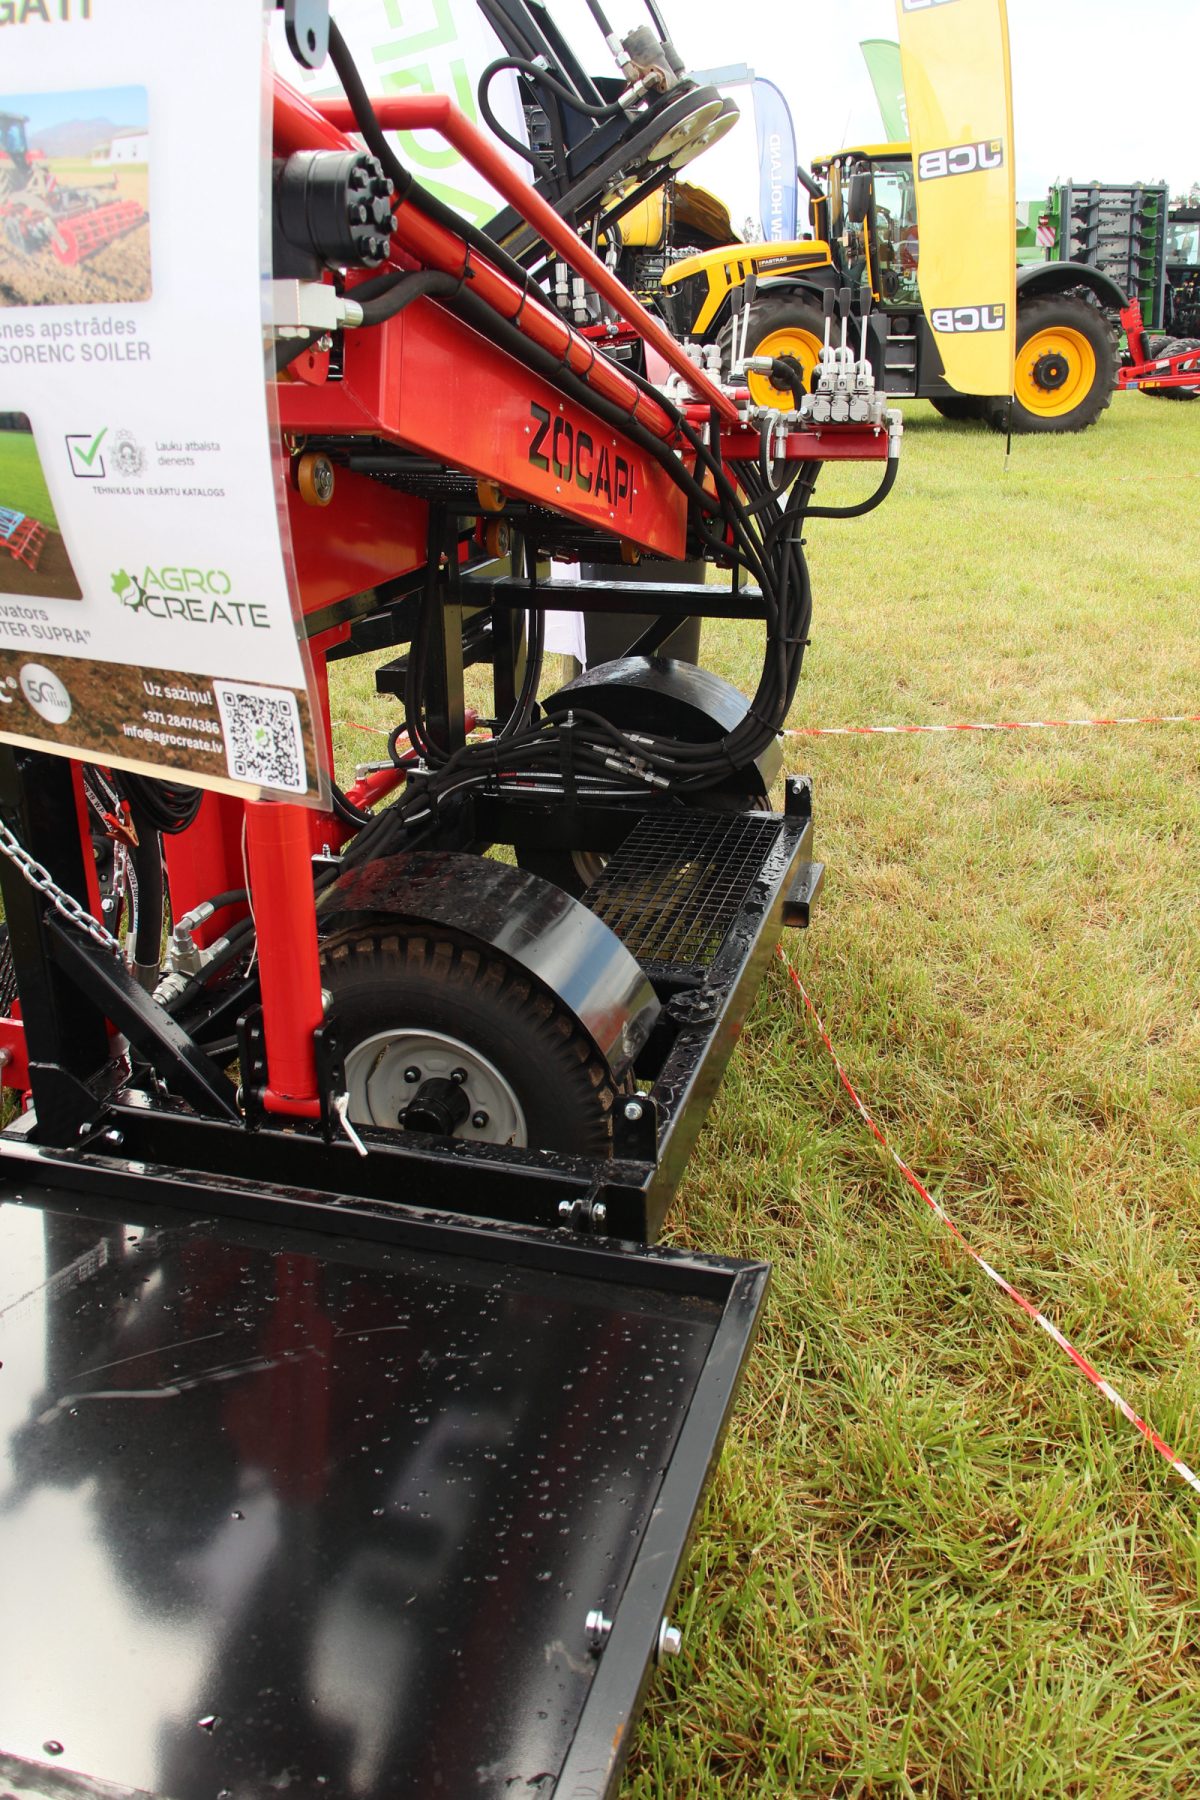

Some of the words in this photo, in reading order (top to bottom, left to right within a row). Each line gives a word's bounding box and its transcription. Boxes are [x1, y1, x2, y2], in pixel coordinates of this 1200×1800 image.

[0, 322, 35, 338] nes
[40, 317, 137, 340] apstrādes
[81, 341, 151, 362] SOILER
[155, 441, 181, 451] Lauku
[185, 441, 220, 451] atbalsta
[529, 400, 634, 514] ZOCAPI
[158, 456, 195, 466] dienests
[93, 485, 131, 495] TEHNIKAS
[133, 486, 144, 495] UN
[182, 487, 225, 497] KATALOGS
[143, 565, 232, 595] AGRO
[0, 604, 49, 621] vators
[144, 595, 271, 629] CREATE
[0, 620, 31, 638] TER
[143, 680, 163, 697] Uz
[164, 686, 213, 707] saziņu!
[142, 710, 166, 725] +371
[167, 714, 220, 735] 28474386
[123, 723, 223, 754] info@agrocreate.lv
